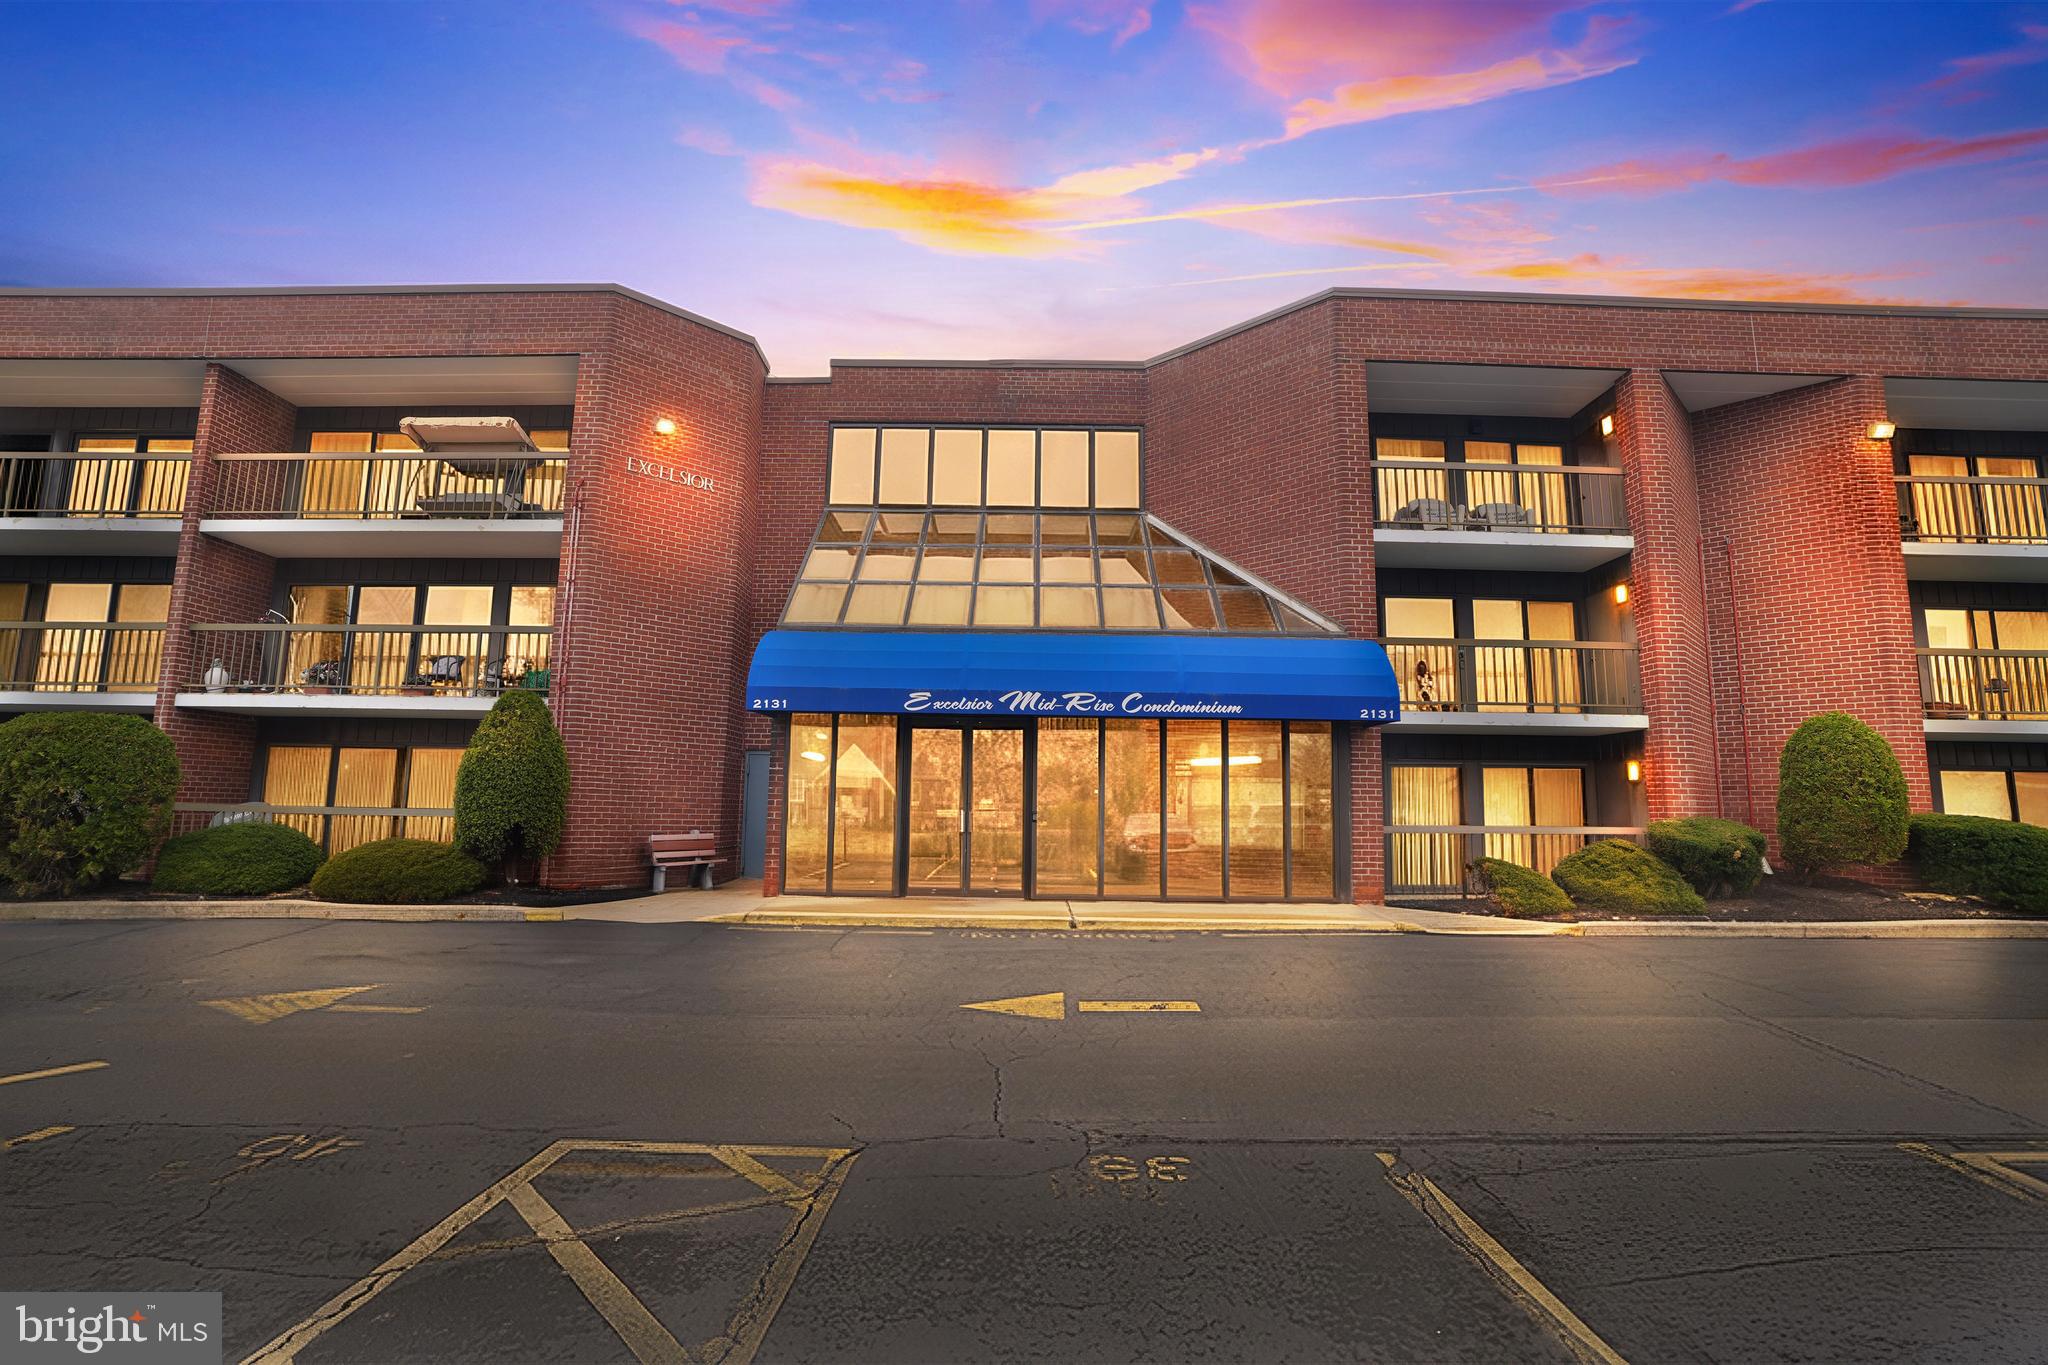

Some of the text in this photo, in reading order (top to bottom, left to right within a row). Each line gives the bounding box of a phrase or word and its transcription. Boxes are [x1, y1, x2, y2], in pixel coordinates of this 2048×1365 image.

[627, 456, 715, 492] EXCELSIOR
[752, 698, 788, 709] 2131
[904, 690, 1243, 713] Excelsior Mid-Rise Condominium
[1360, 708, 1395, 720] 2131
